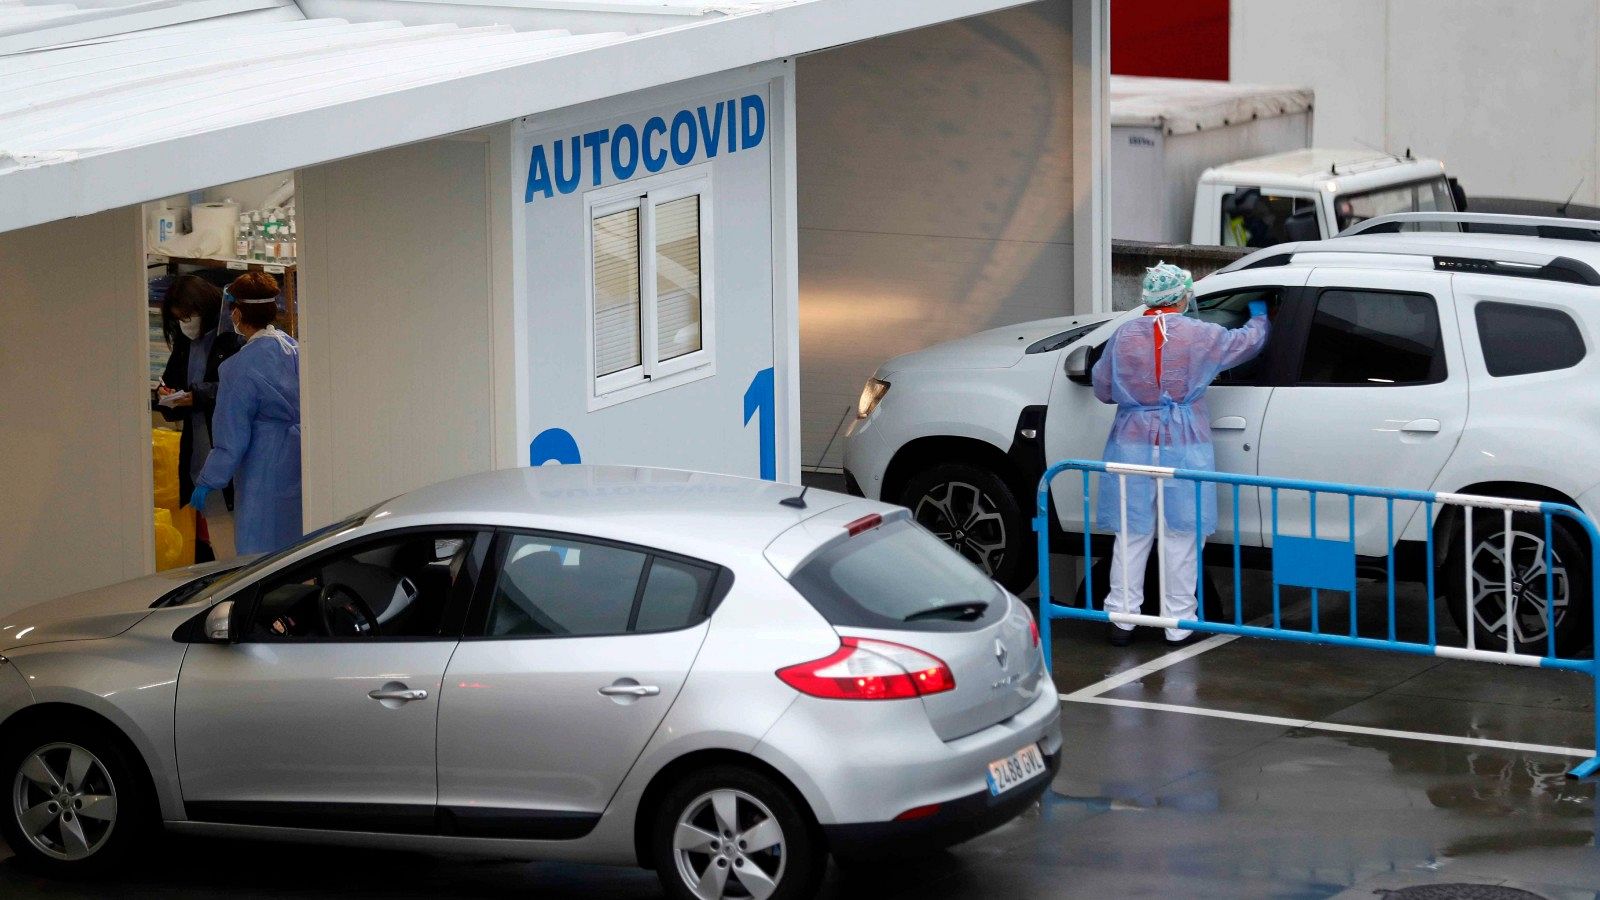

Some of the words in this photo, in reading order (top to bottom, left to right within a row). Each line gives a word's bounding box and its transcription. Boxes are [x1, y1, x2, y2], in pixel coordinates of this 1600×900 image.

[525, 94, 766, 204] AUTOCOVID
[743, 367, 777, 482] 1
[994, 758, 1024, 789] 2488
